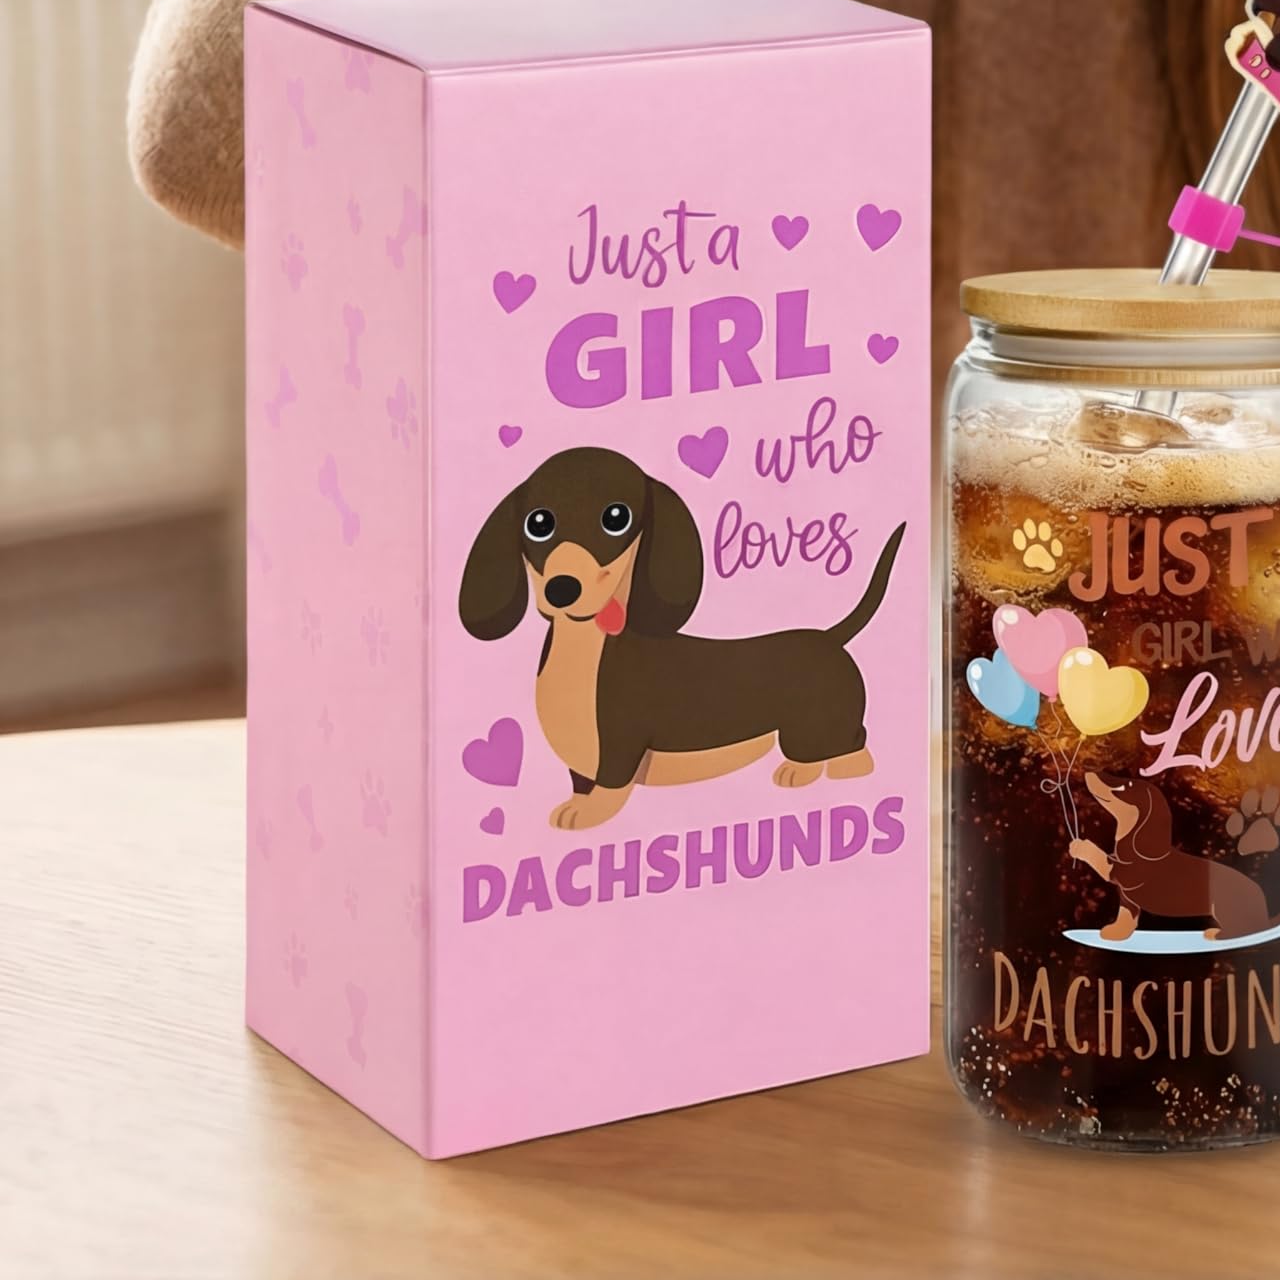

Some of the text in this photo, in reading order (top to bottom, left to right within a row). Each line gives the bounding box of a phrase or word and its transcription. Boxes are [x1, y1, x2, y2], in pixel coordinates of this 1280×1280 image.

[568, 200, 740, 288] Just a
[545, 289, 831, 409] GIRL
[755, 397, 883, 483] who
[713, 501, 859, 579] loves
[1068, 508, 1274, 602] JUST
[1132, 620, 1233, 666] GIRL
[463, 796, 906, 923] DACHSHUNDS
